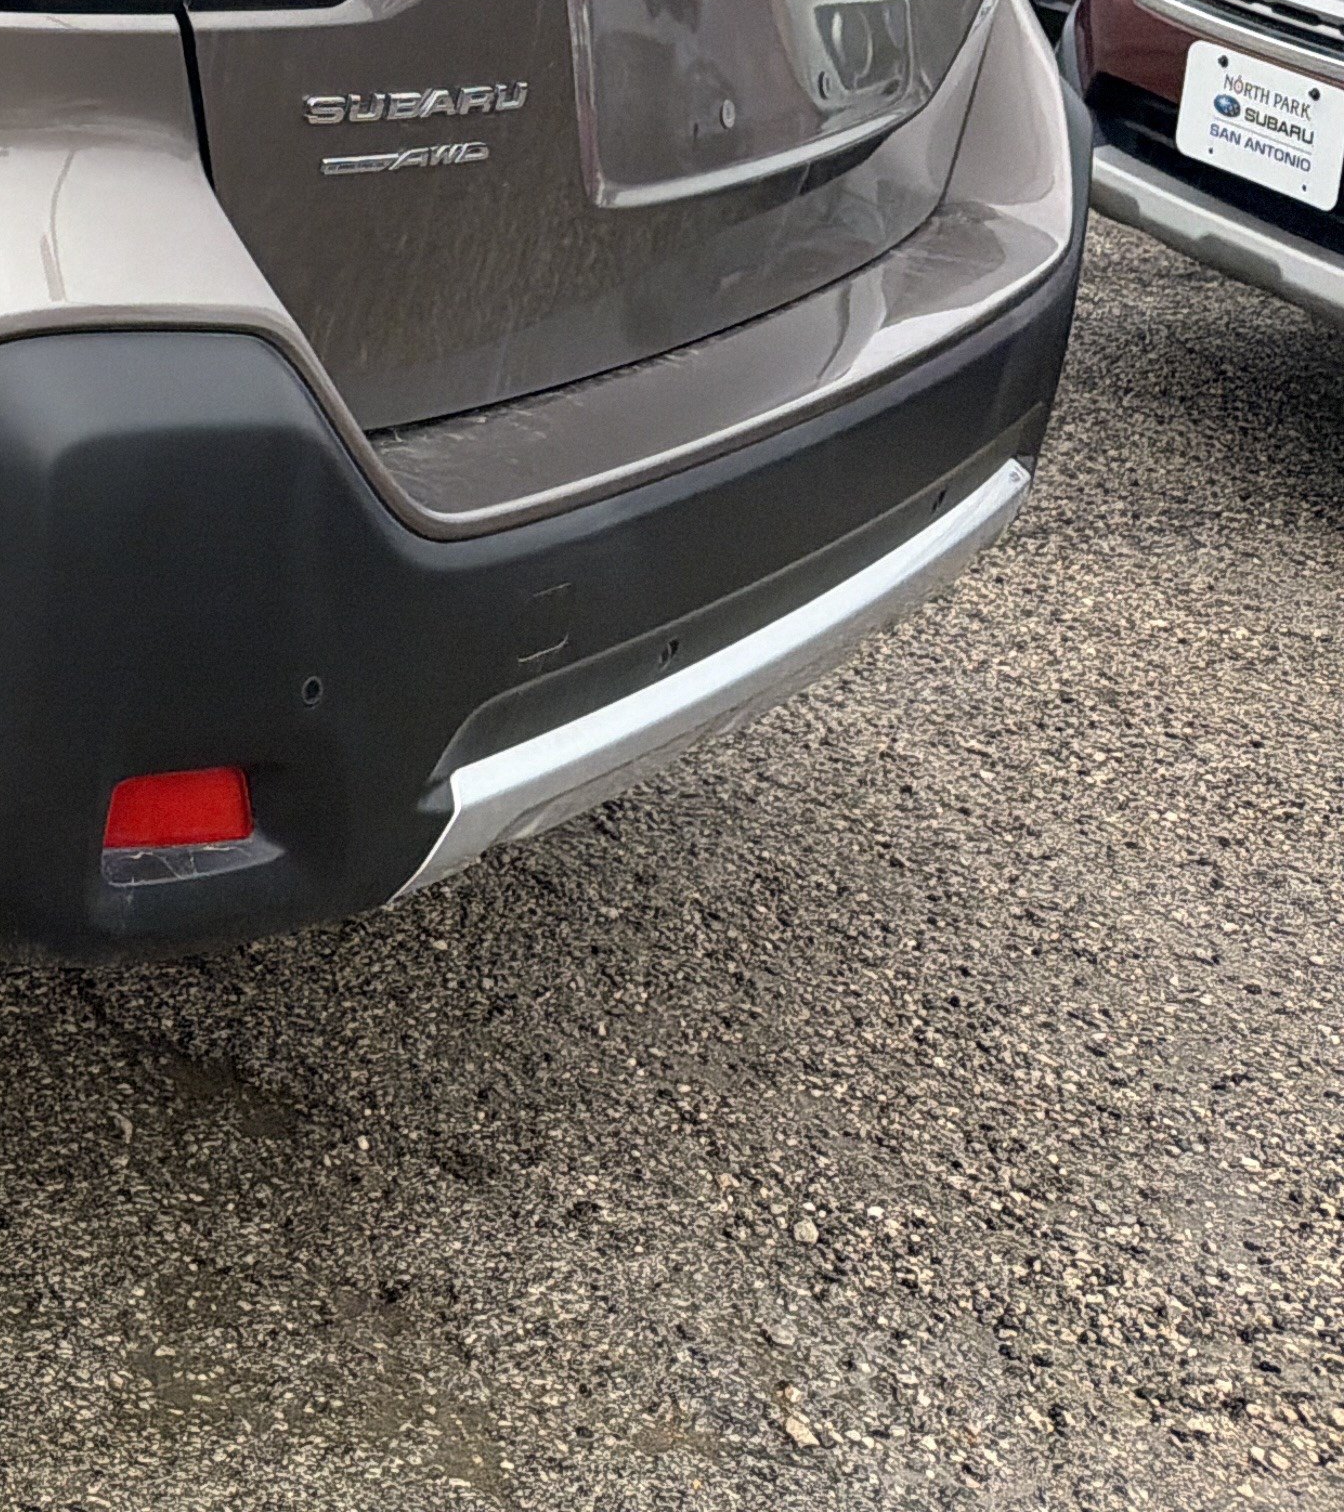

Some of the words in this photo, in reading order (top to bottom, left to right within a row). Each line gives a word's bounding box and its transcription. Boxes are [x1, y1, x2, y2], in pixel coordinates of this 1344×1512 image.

[302, 81, 528, 125] SUBARU
[1223, 73, 1270, 105] NORTH
[1274, 93, 1312, 121] PARK
[1209, 123, 1242, 146] SAN
[1244, 138, 1312, 172] ANTONIO
[1244, 107, 1314, 145] SUBARU
